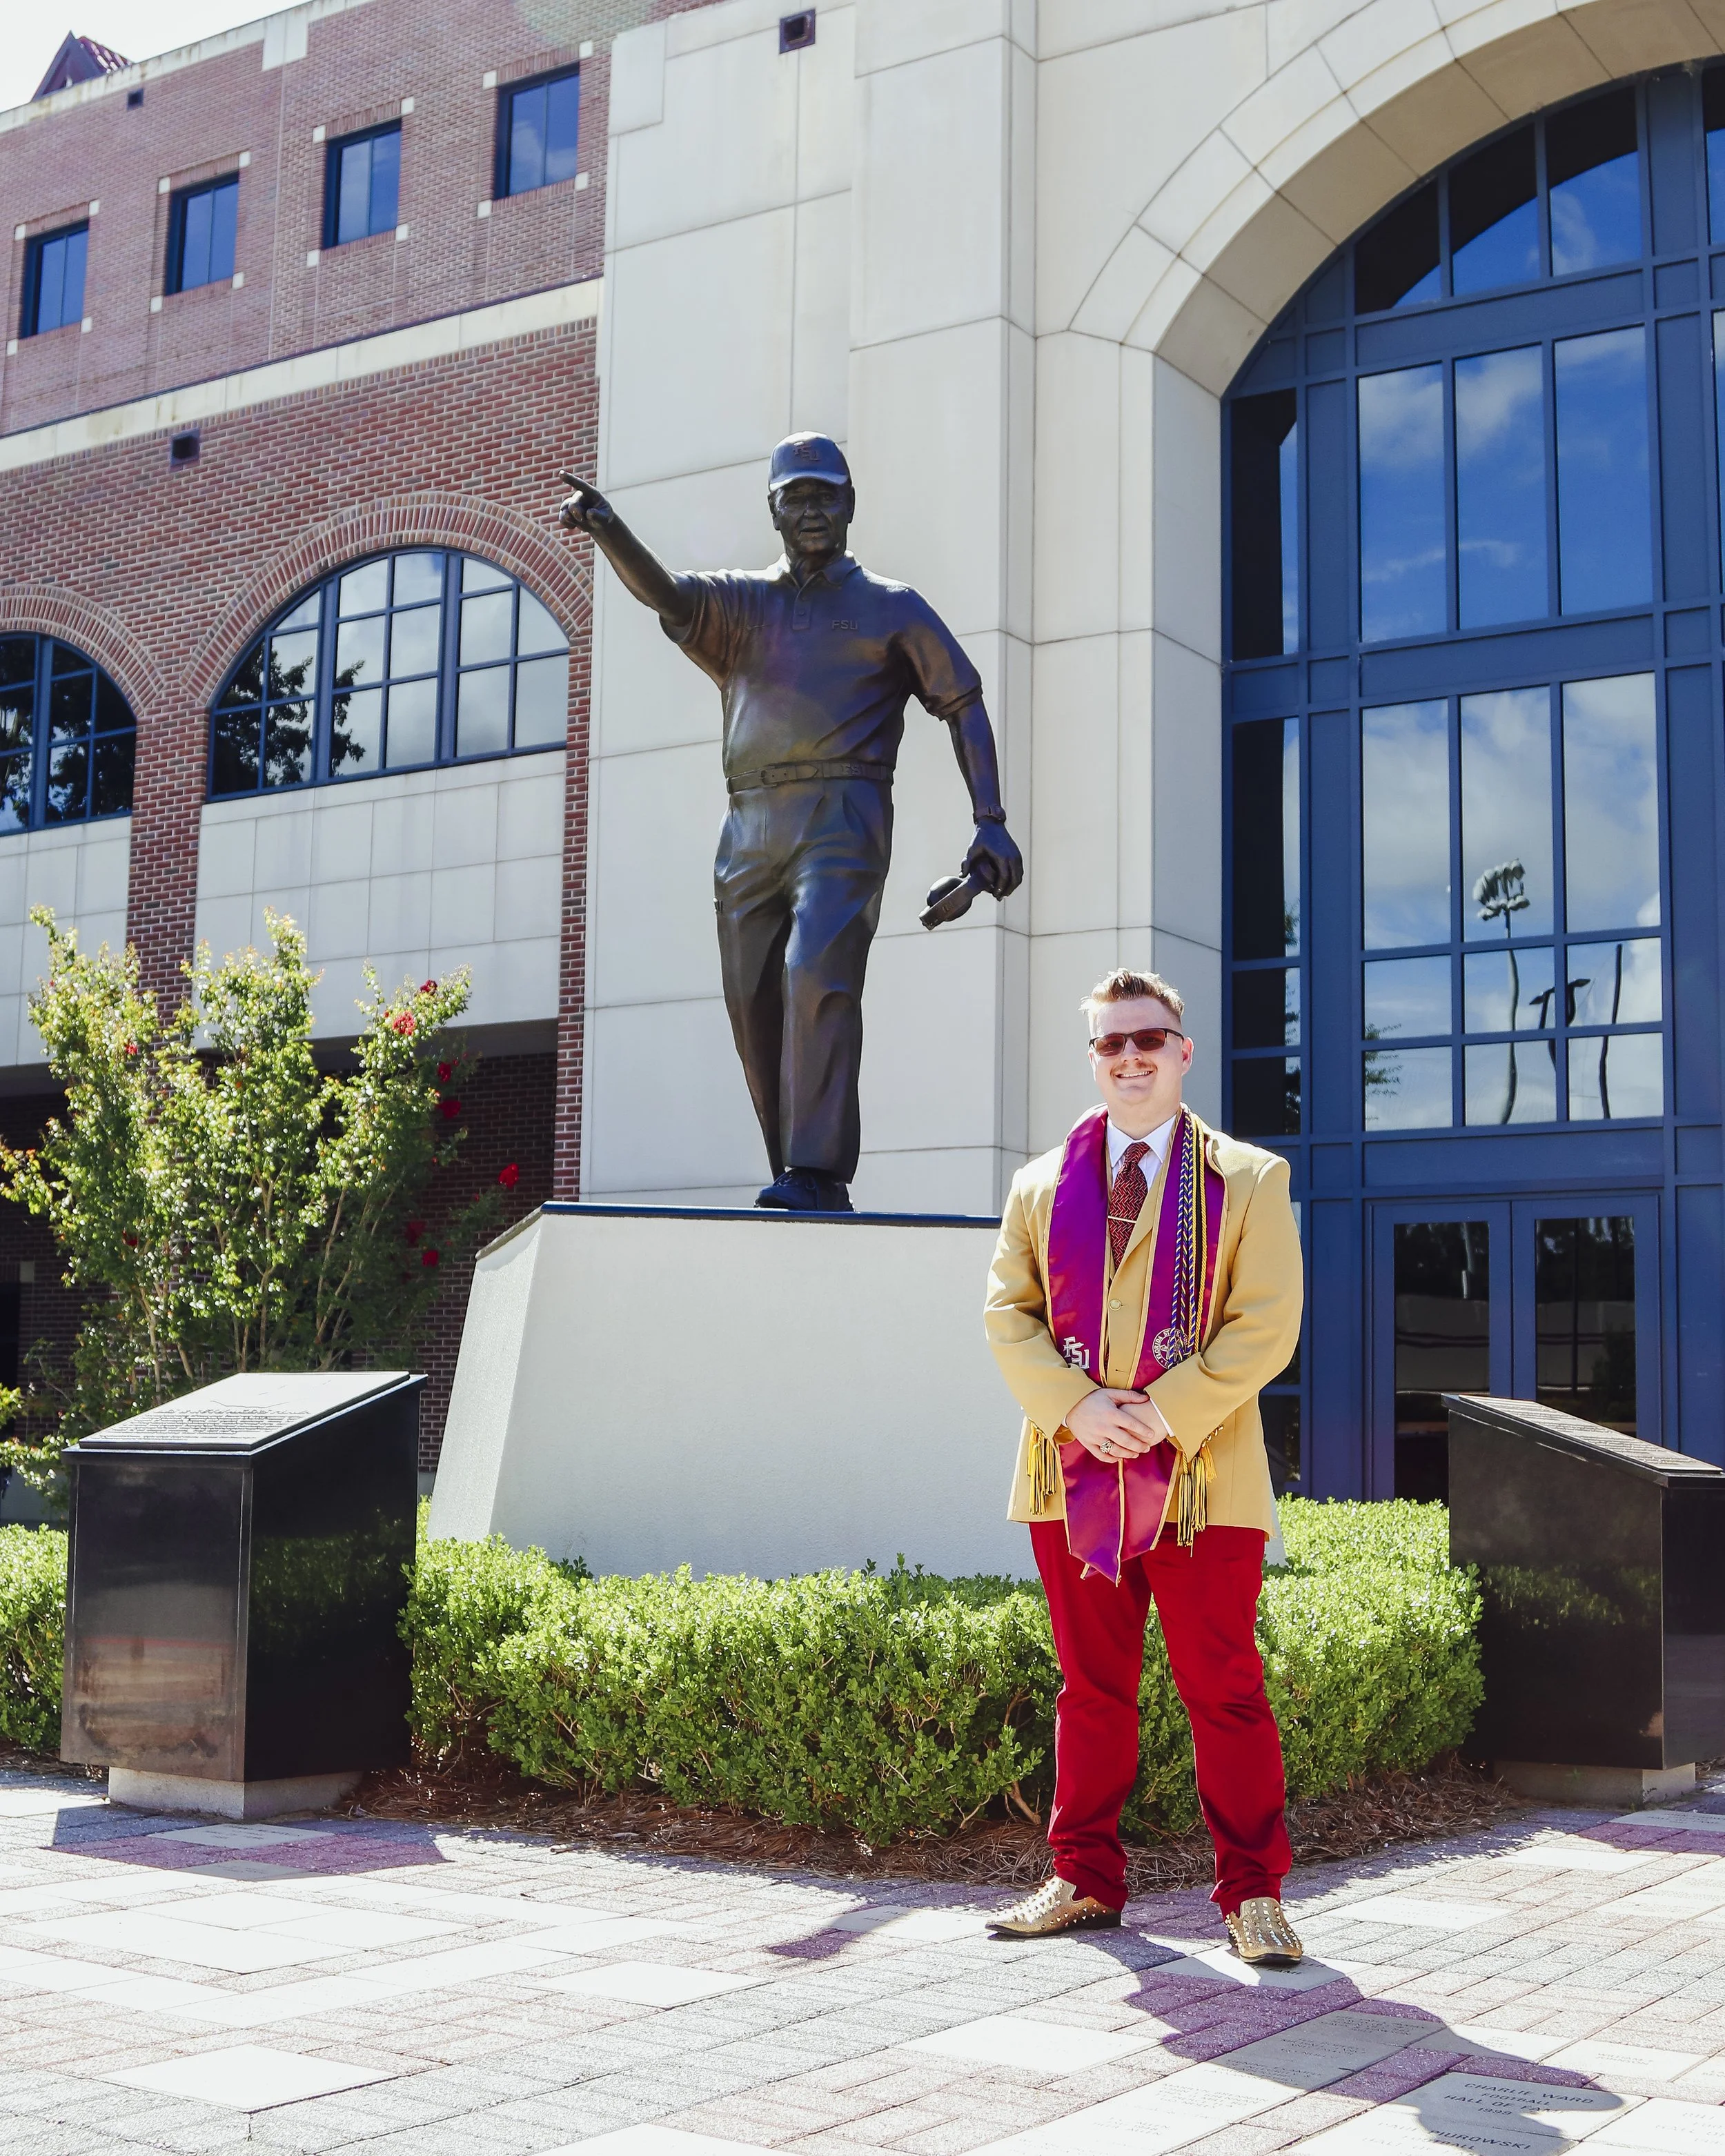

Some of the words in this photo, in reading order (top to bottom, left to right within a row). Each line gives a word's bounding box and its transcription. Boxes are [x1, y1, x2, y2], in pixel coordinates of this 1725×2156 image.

[831, 620, 858, 631] FSU
[1063, 1336, 1090, 1369] FSU
[1154, 1335, 1163, 1361] FLORIDA
[1443, 2094, 1483, 2105] HALL
[1463, 2082, 1534, 2097] CHARLIE
[1541, 2092, 1595, 2104] WARD
[1481, 2093, 1550, 2106] FOOTBALL
[1477, 2107, 1512, 2116] 1999
[1428, 2129, 1532, 2151] PIUROWSKI
